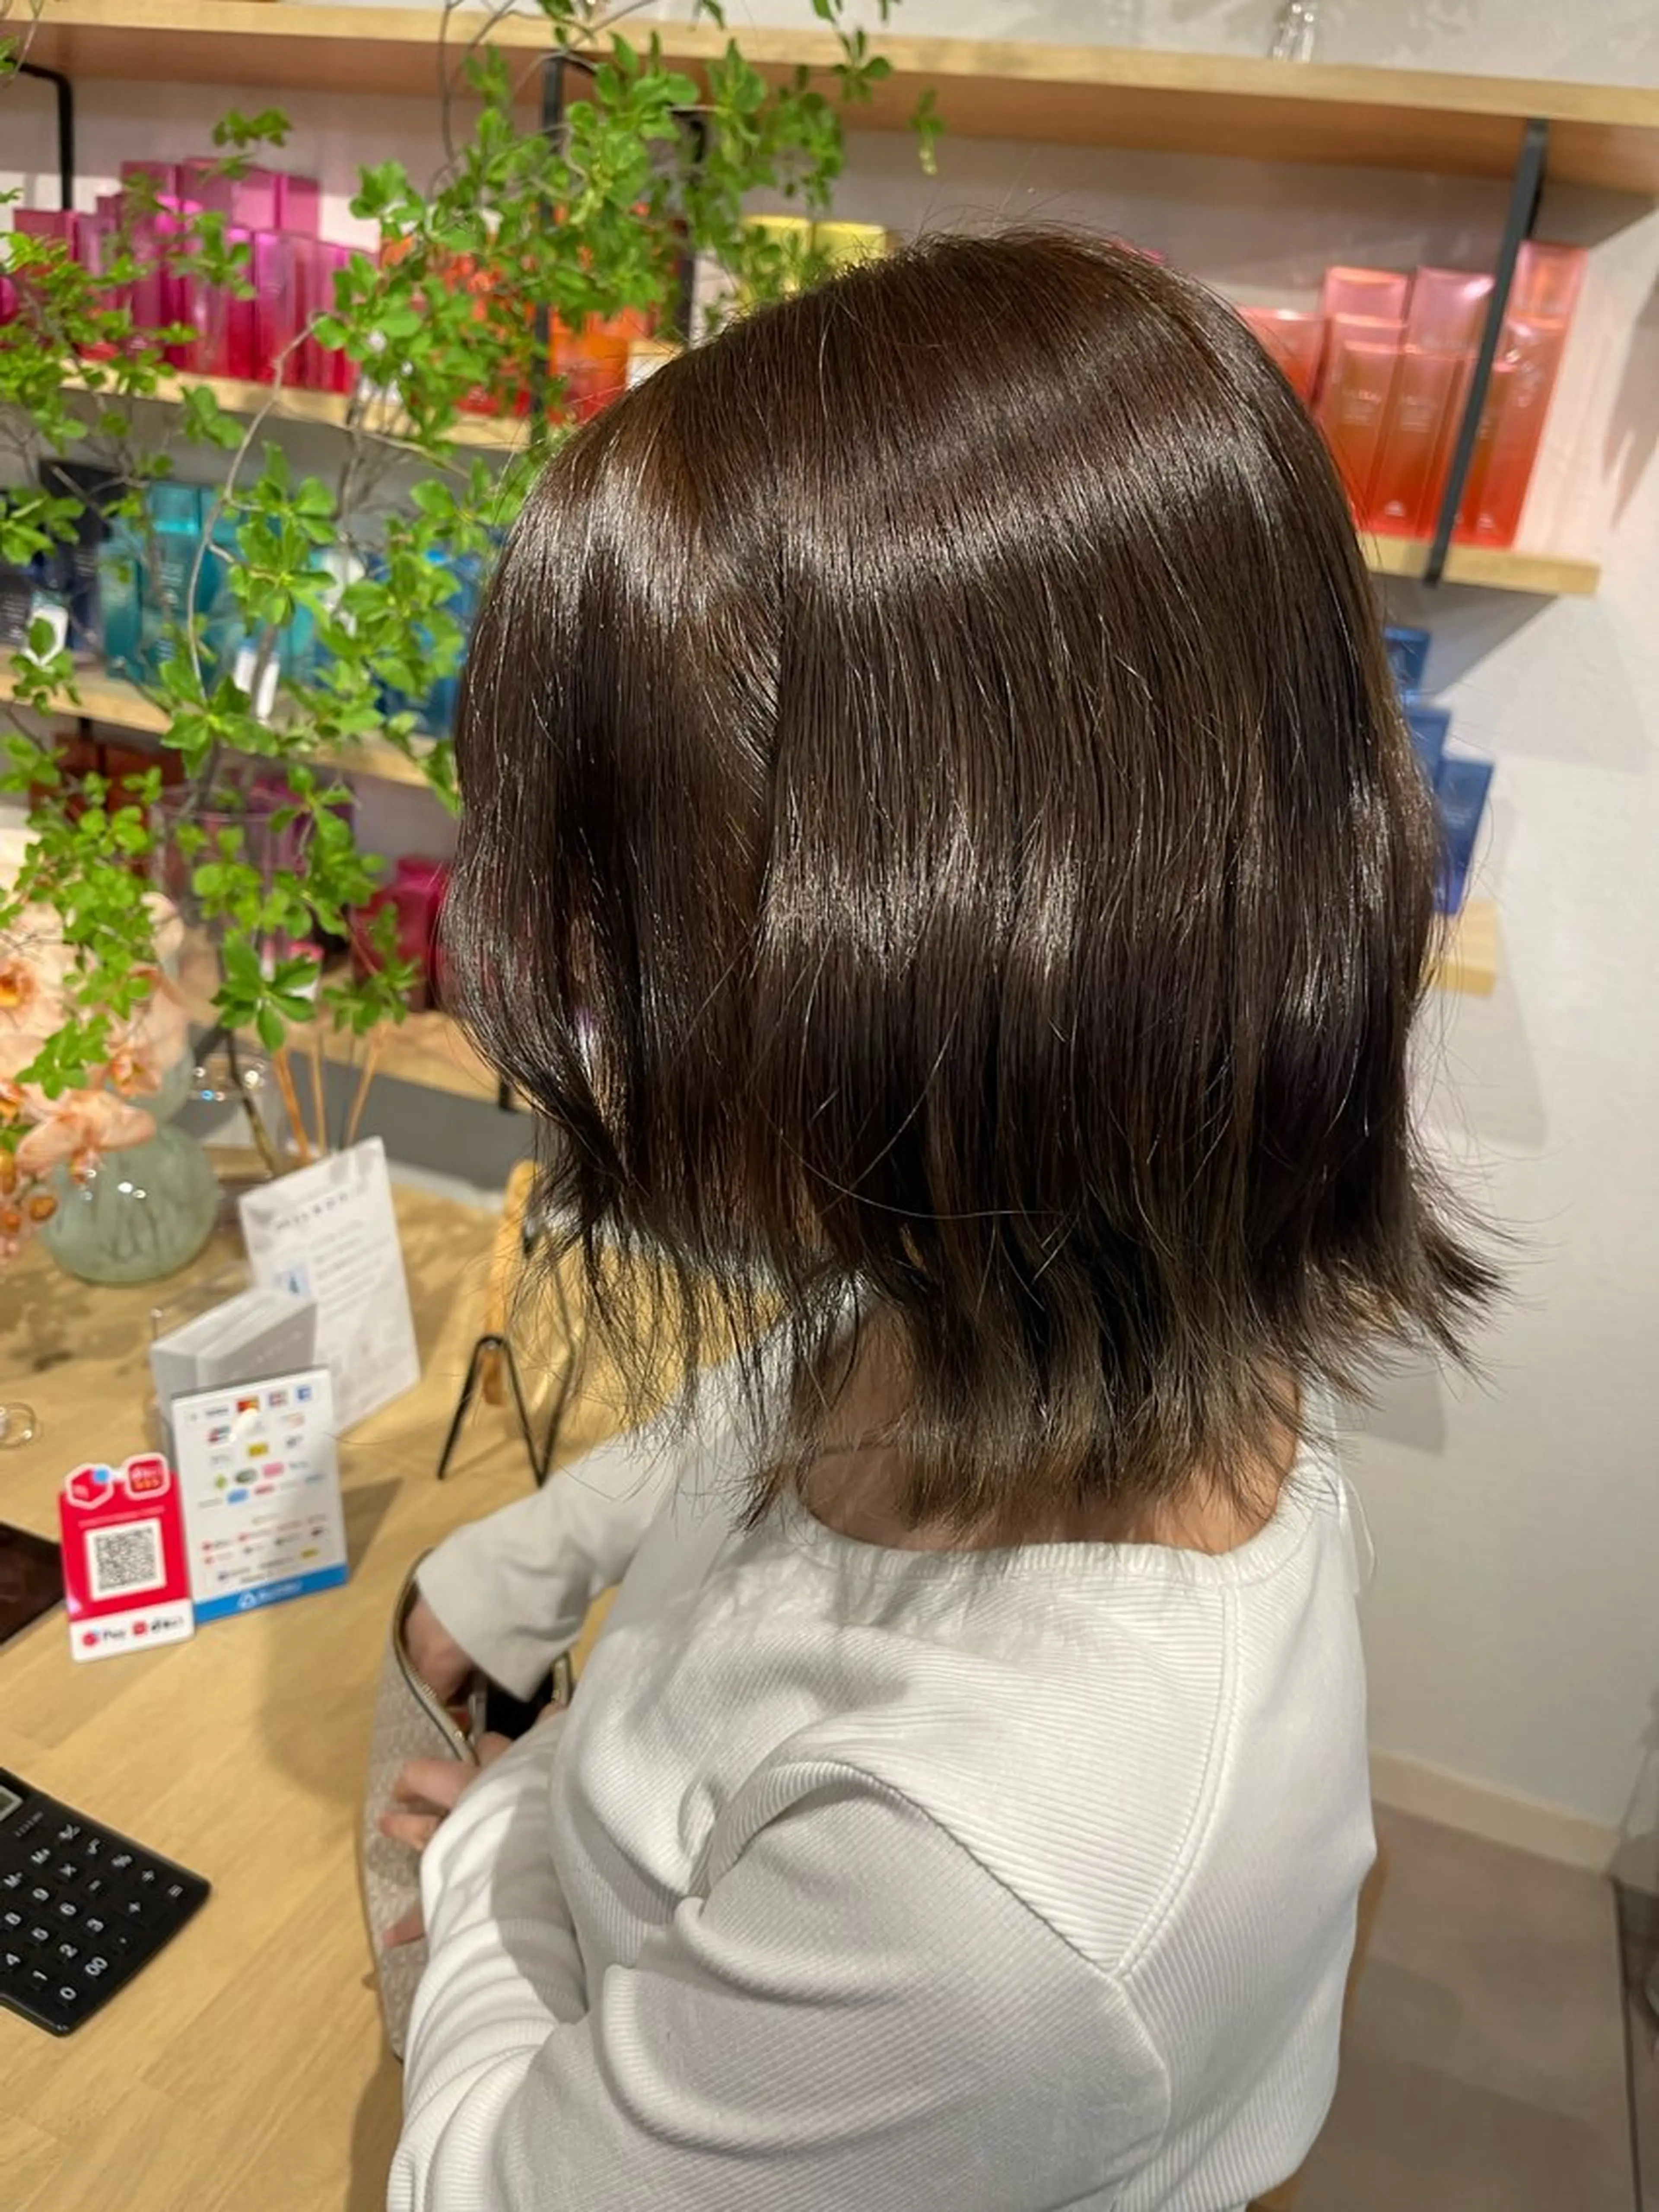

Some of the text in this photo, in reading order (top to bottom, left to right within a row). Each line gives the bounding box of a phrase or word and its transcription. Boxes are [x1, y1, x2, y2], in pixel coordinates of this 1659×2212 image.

[59, 1944, 78, 1958] 2
[6, 1953, 21, 1966] 4
[84, 1956, 108, 1976] 00
[32, 1970, 48, 1981] 1
[59, 1986, 76, 2000] 0
